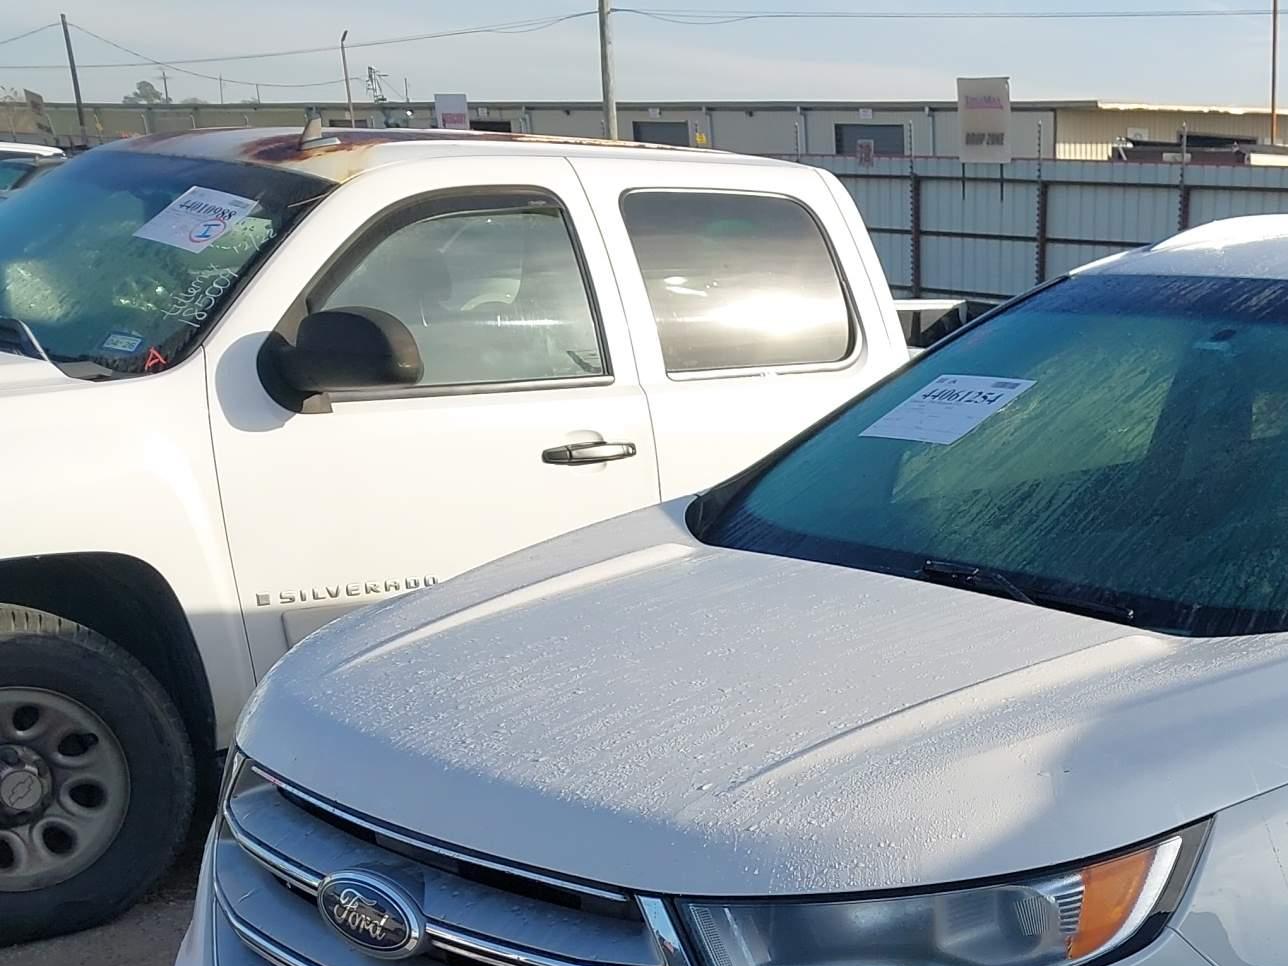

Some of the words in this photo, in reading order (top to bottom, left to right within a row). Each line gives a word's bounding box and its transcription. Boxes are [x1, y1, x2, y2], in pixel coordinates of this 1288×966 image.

[922, 387, 1005, 405] 44061254
[279, 574, 440, 605] SILVERADO
[333, 888, 389, 940] Ford
